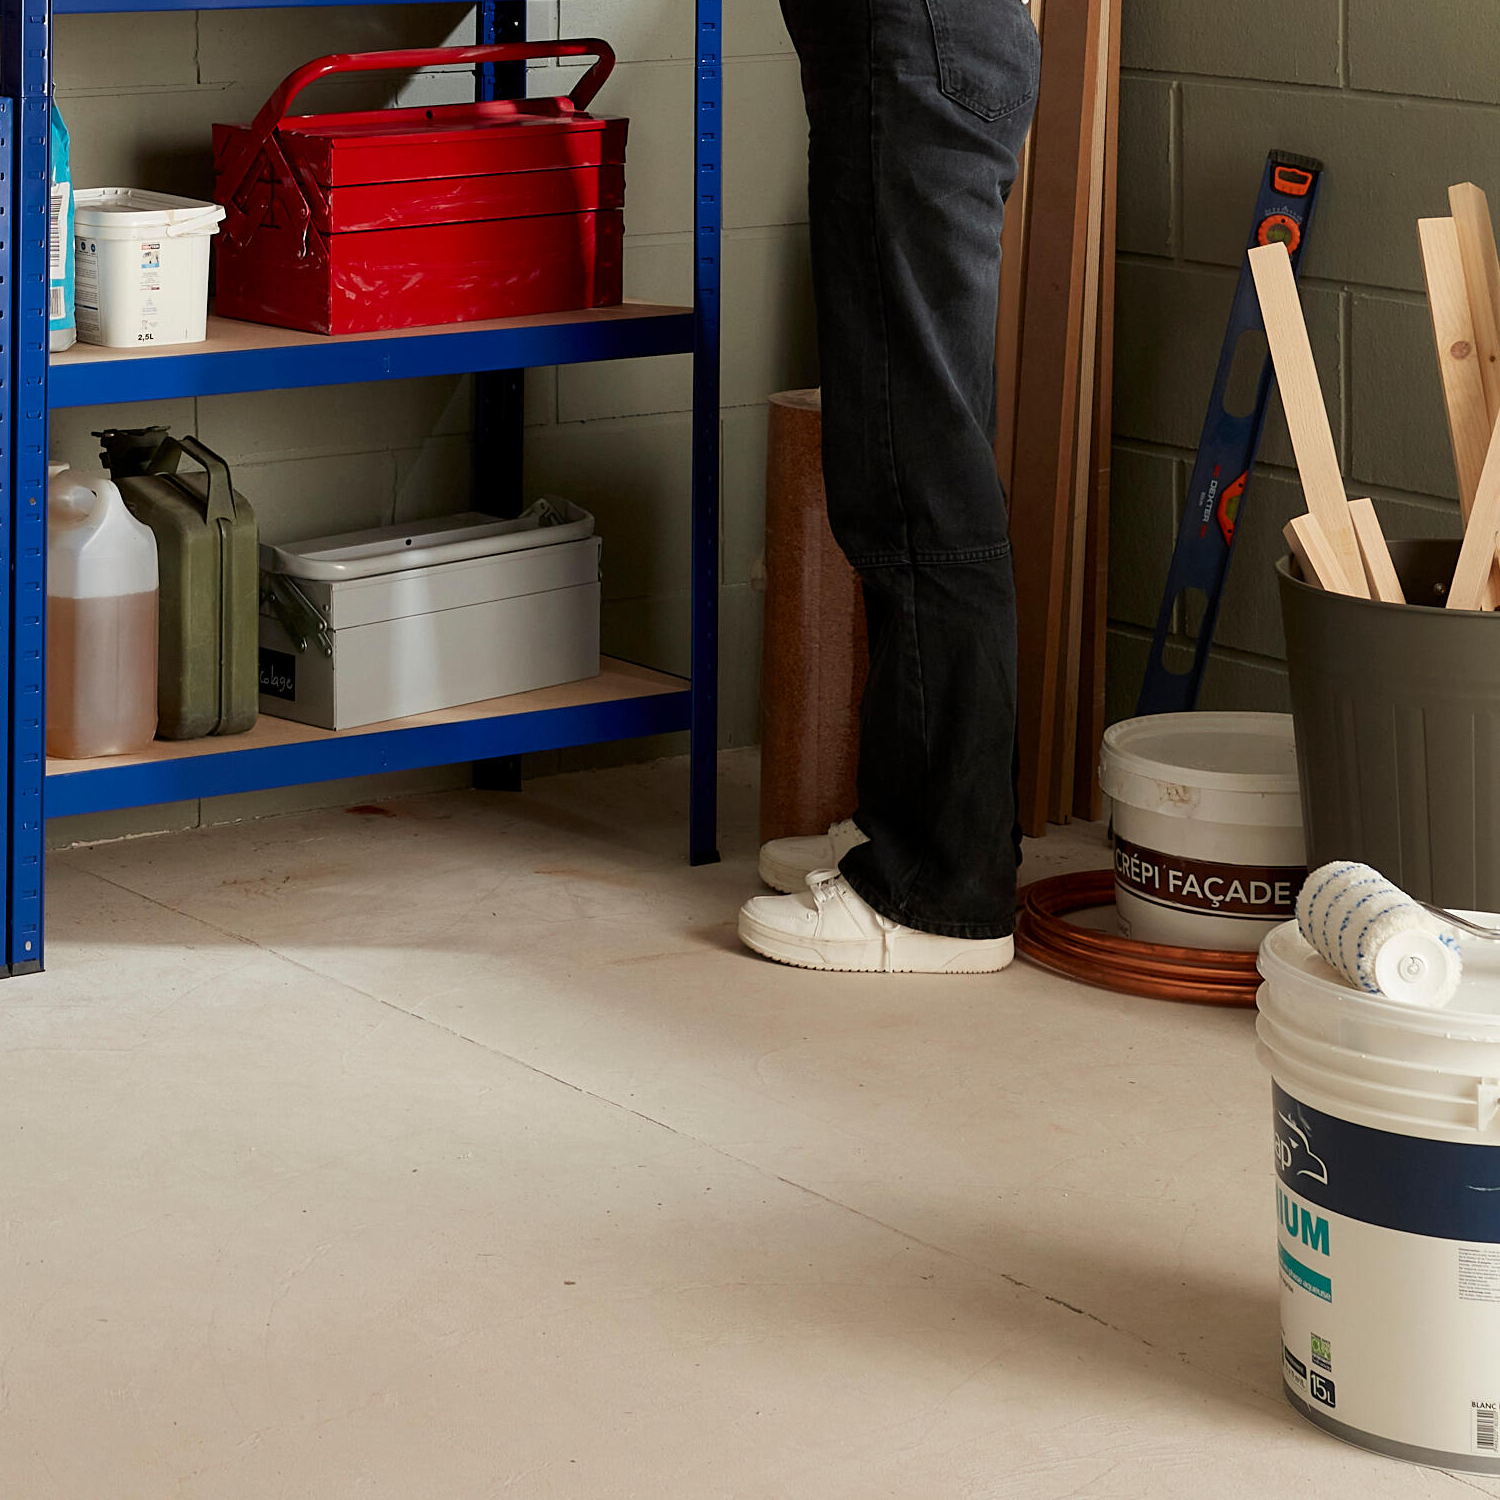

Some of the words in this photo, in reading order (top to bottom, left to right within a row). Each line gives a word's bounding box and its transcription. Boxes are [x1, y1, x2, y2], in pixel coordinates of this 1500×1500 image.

[137, 333, 154, 342] 2,5L
[1202, 479, 1218, 523] DEXTER
[1115, 848, 1160, 889] CRÉPI
[1168, 869, 1292, 908] FAÇADE
[1310, 1372, 1335, 1406] 15L
[1471, 1401, 1497, 1410] BLANC
